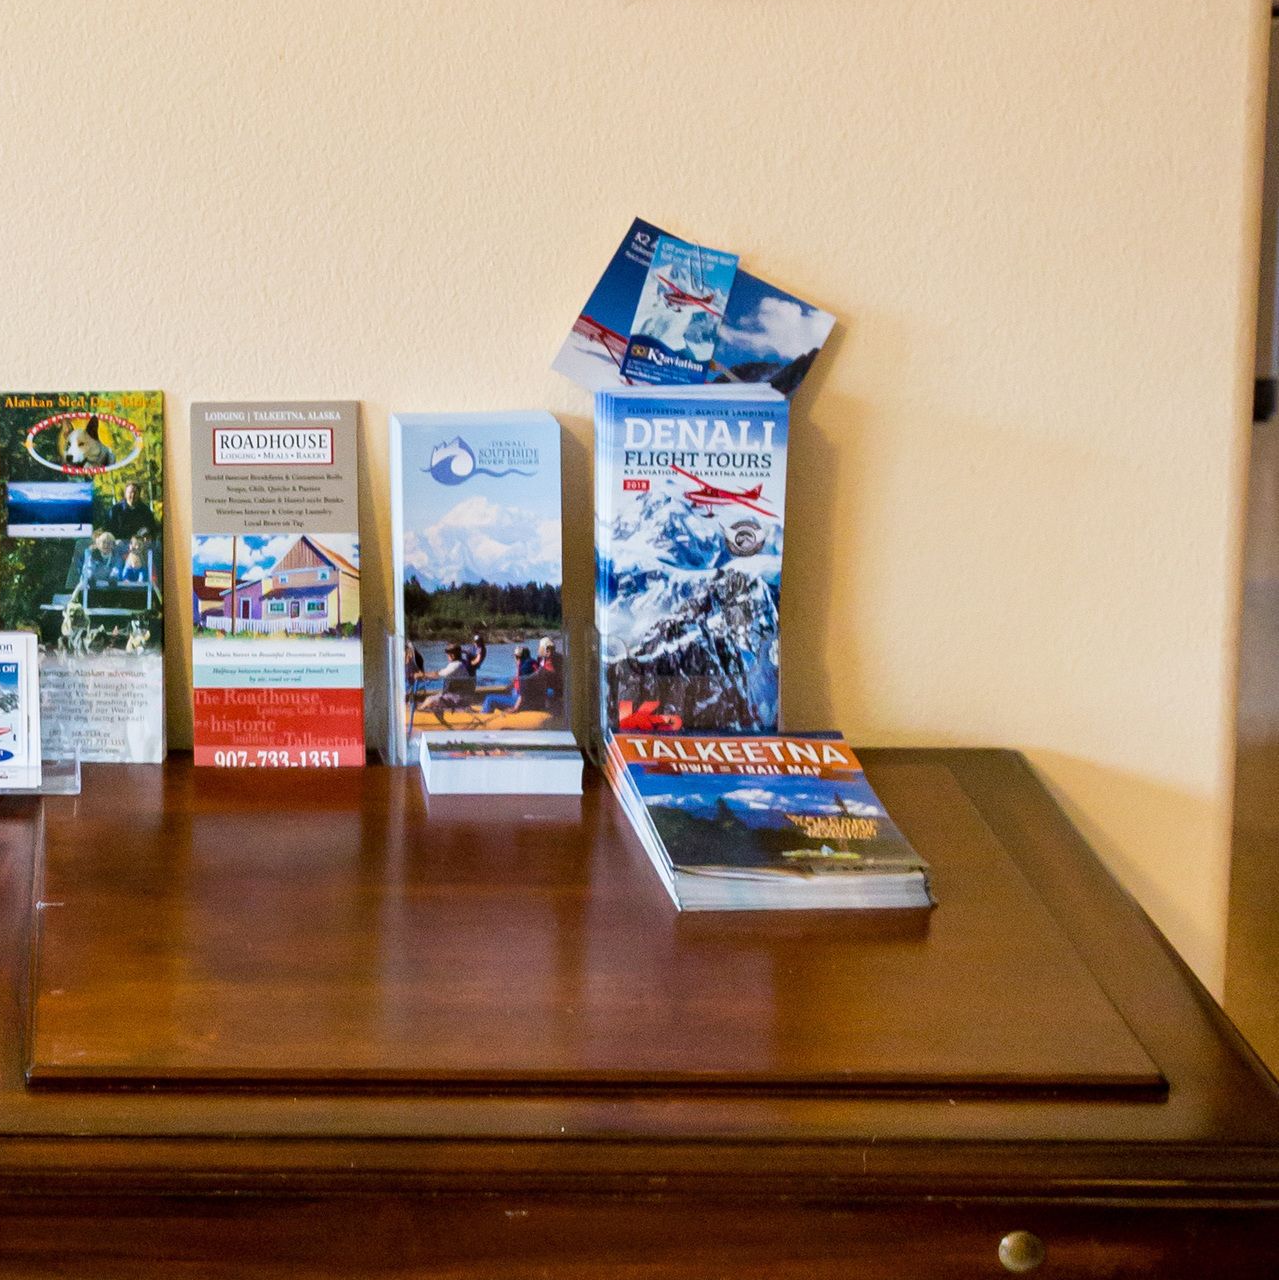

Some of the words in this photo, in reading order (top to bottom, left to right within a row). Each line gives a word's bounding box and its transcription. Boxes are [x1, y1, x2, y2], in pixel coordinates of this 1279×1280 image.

[5, 396, 53, 408] Alaskan
[58, 396, 86, 408] Sled
[204, 411, 245, 421] LODGING
[254, 411, 305, 421] TALKEETNA,
[308, 411, 341, 420] ALASKA
[624, 417, 776, 450] DENALI
[220, 433, 328, 450] ROADHOUSE
[220, 451, 257, 460] LODGING
[263, 451, 289, 459] MEALS
[296, 451, 326, 459] BAKERY
[624, 450, 700, 468] FLIGHT
[704, 452, 772, 469] TOURS
[637, 469, 679, 477] AVIATION
[195, 690, 220, 704] The
[211, 715, 276, 732] historic
[626, 738, 849, 765] TALKEETNA
[737, 764, 781, 775] TRAIL
